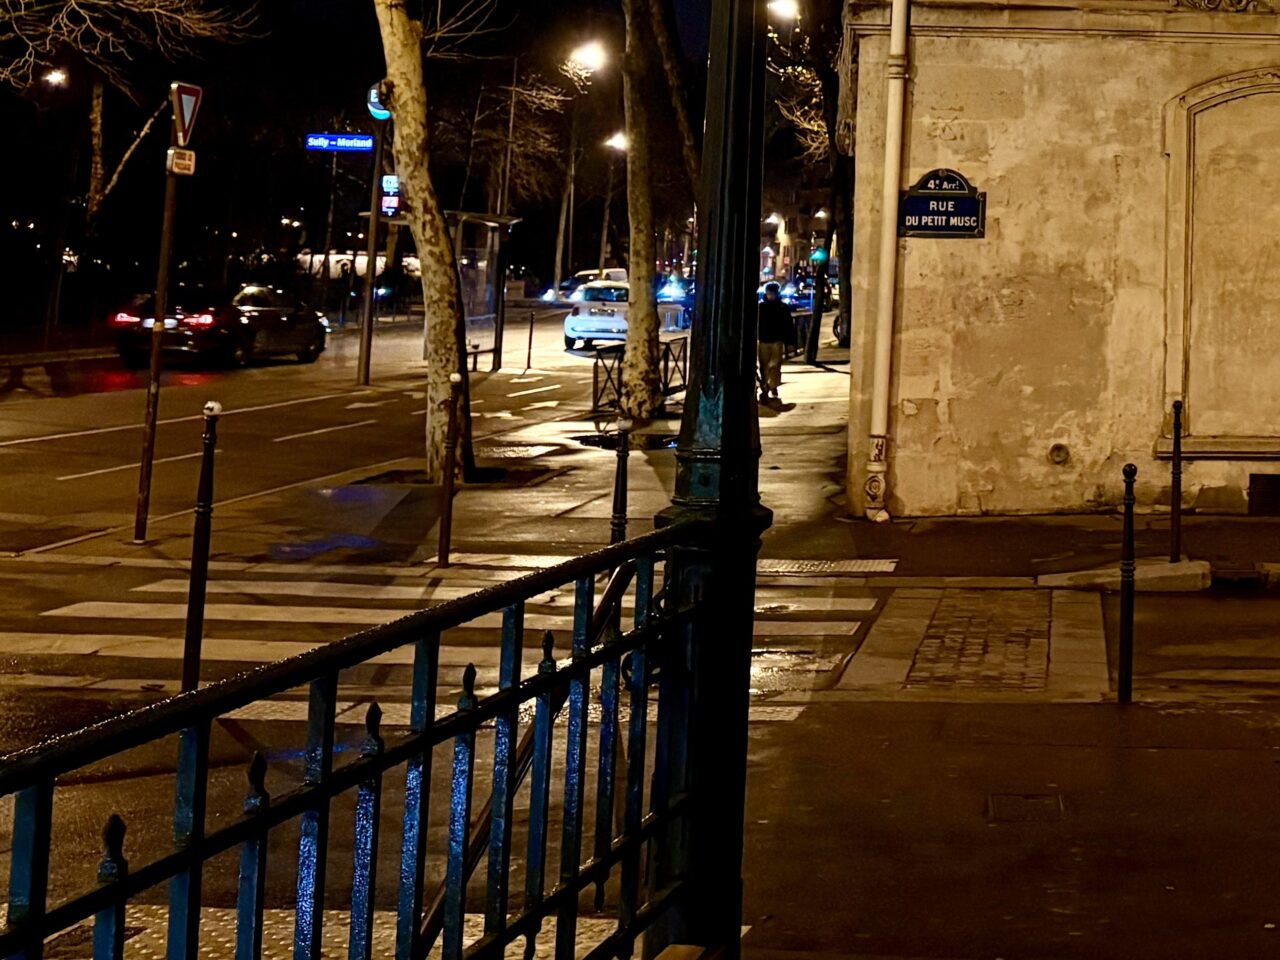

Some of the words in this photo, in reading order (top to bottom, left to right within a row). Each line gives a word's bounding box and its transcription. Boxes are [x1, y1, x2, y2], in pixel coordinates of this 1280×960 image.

[308, 137, 329, 148] Sully
[337, 138, 373, 147] Morland
[929, 201, 955, 211] RUE
[905, 216, 919, 226] DU
[921, 216, 947, 226] PETIT
[949, 216, 977, 227] MUSC
